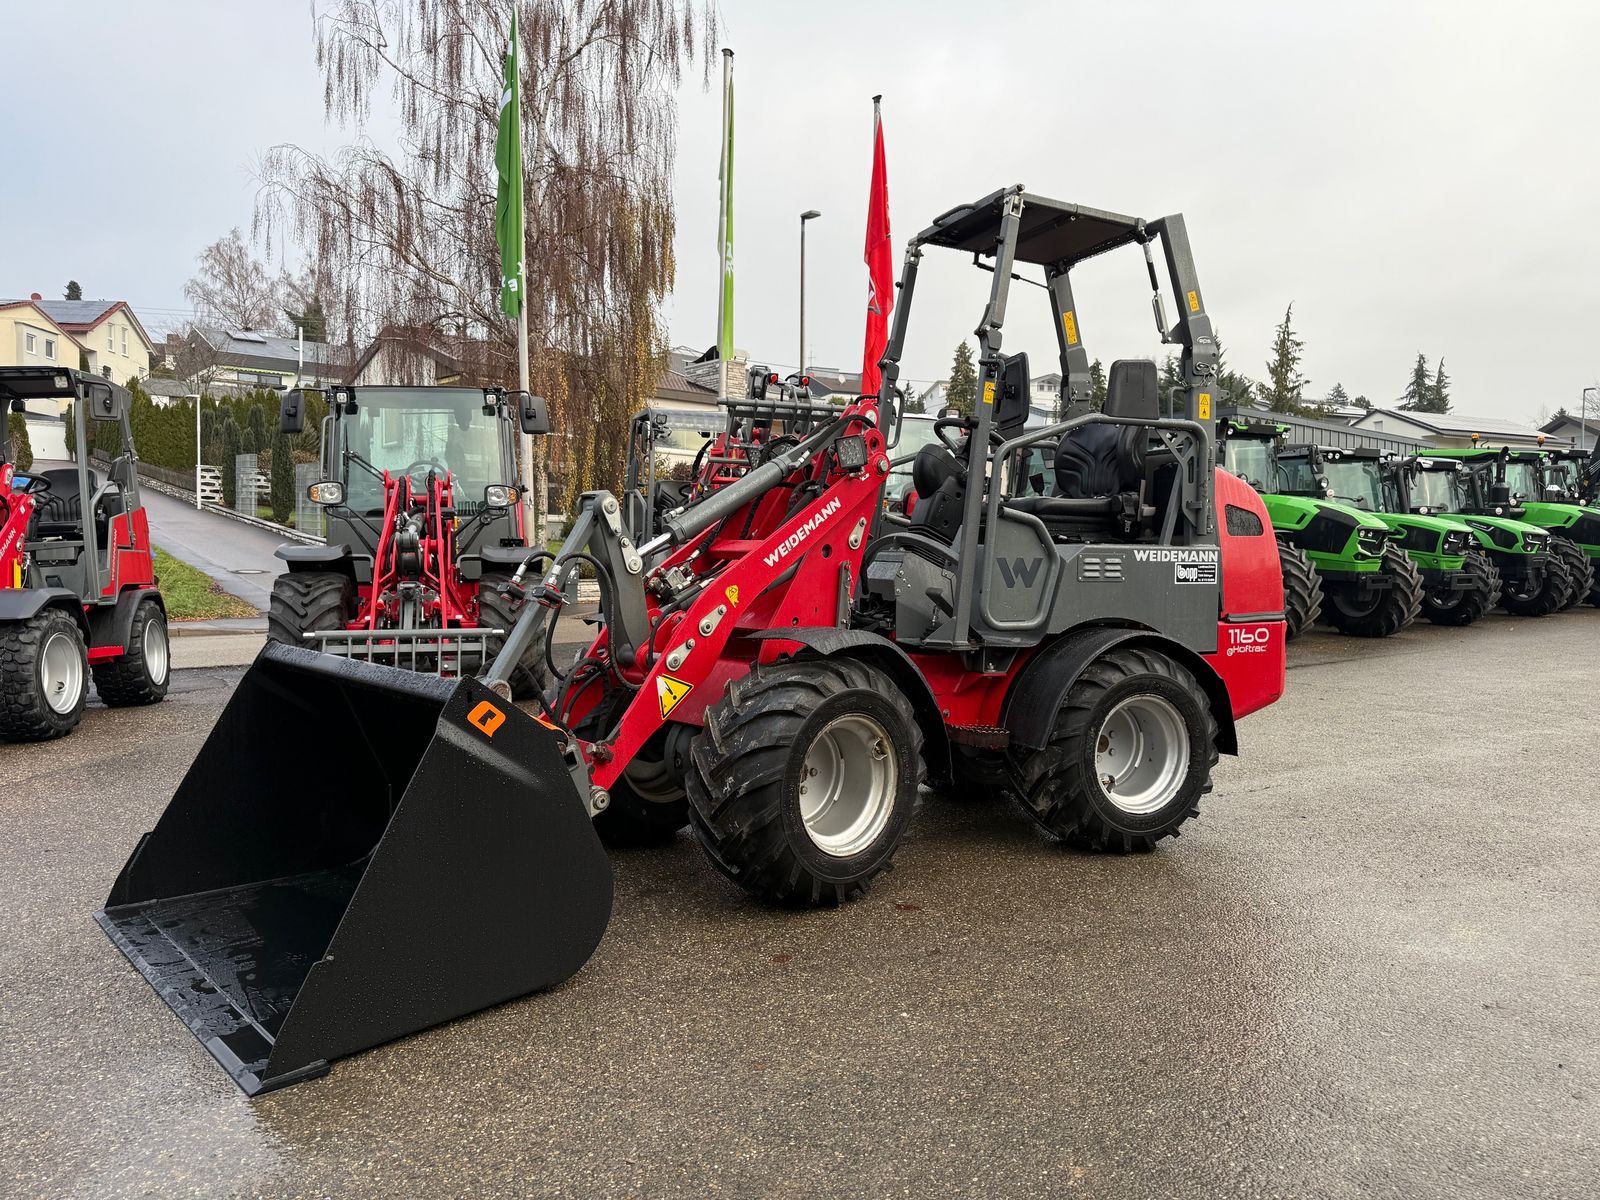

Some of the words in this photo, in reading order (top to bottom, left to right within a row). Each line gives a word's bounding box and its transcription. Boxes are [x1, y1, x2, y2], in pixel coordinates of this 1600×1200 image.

[762, 496, 842, 568] WEIDEMANN
[1133, 549, 1219, 562] WEIDEMANN
[1228, 627, 1270, 644] 1160
